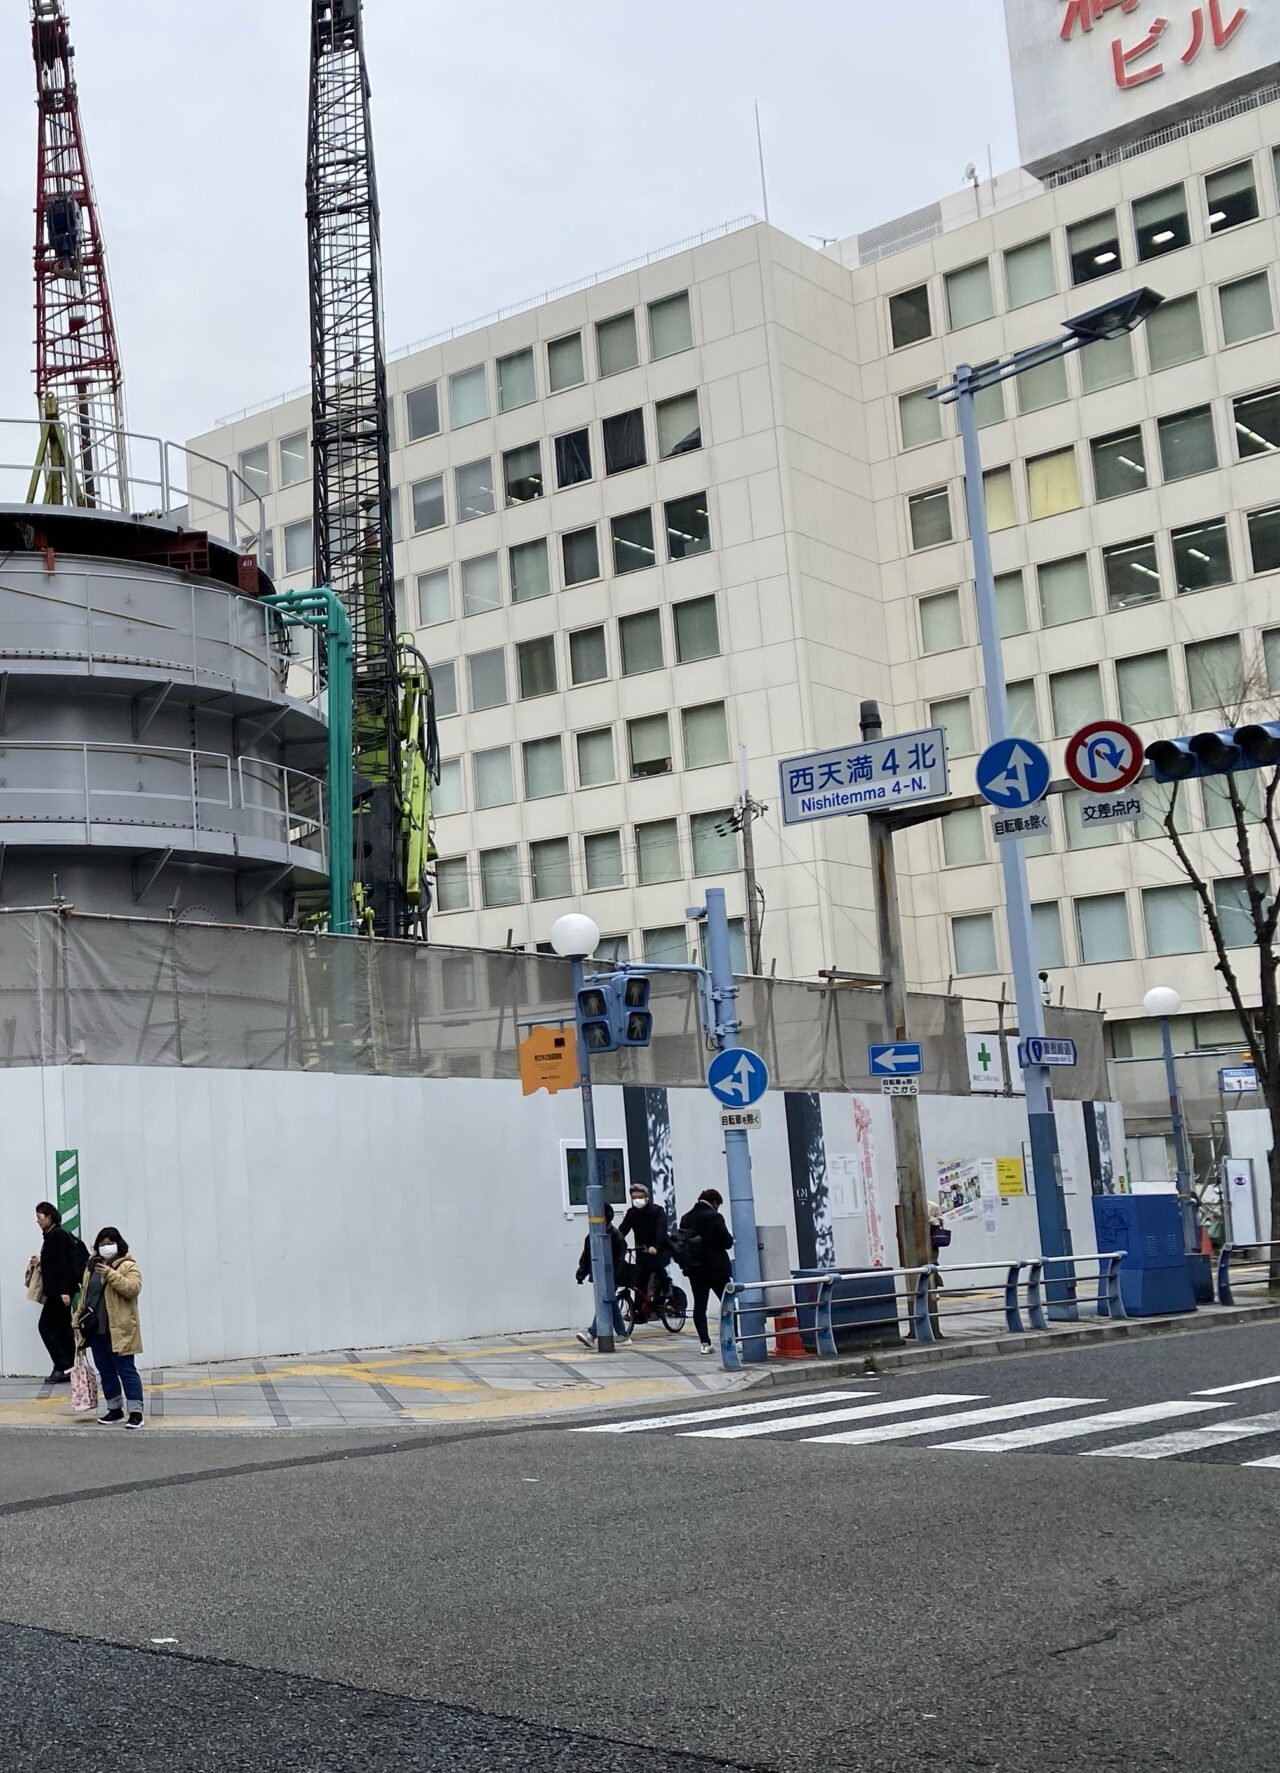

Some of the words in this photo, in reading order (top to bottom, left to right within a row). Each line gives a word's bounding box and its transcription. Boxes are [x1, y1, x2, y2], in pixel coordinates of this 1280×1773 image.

[1111, 0, 1249, 89] ビル
[788, 742, 937, 795] 西天満4北
[801, 786, 886, 813] Nishitemma
[891, 776, 927, 795] 4-N.
[1083, 798, 1141, 822] 交差点内
[994, 814, 1049, 836] 自転車を除く
[883, 1085, 918, 1095] ここから
[721, 1113, 760, 1126] 自転車を除く
